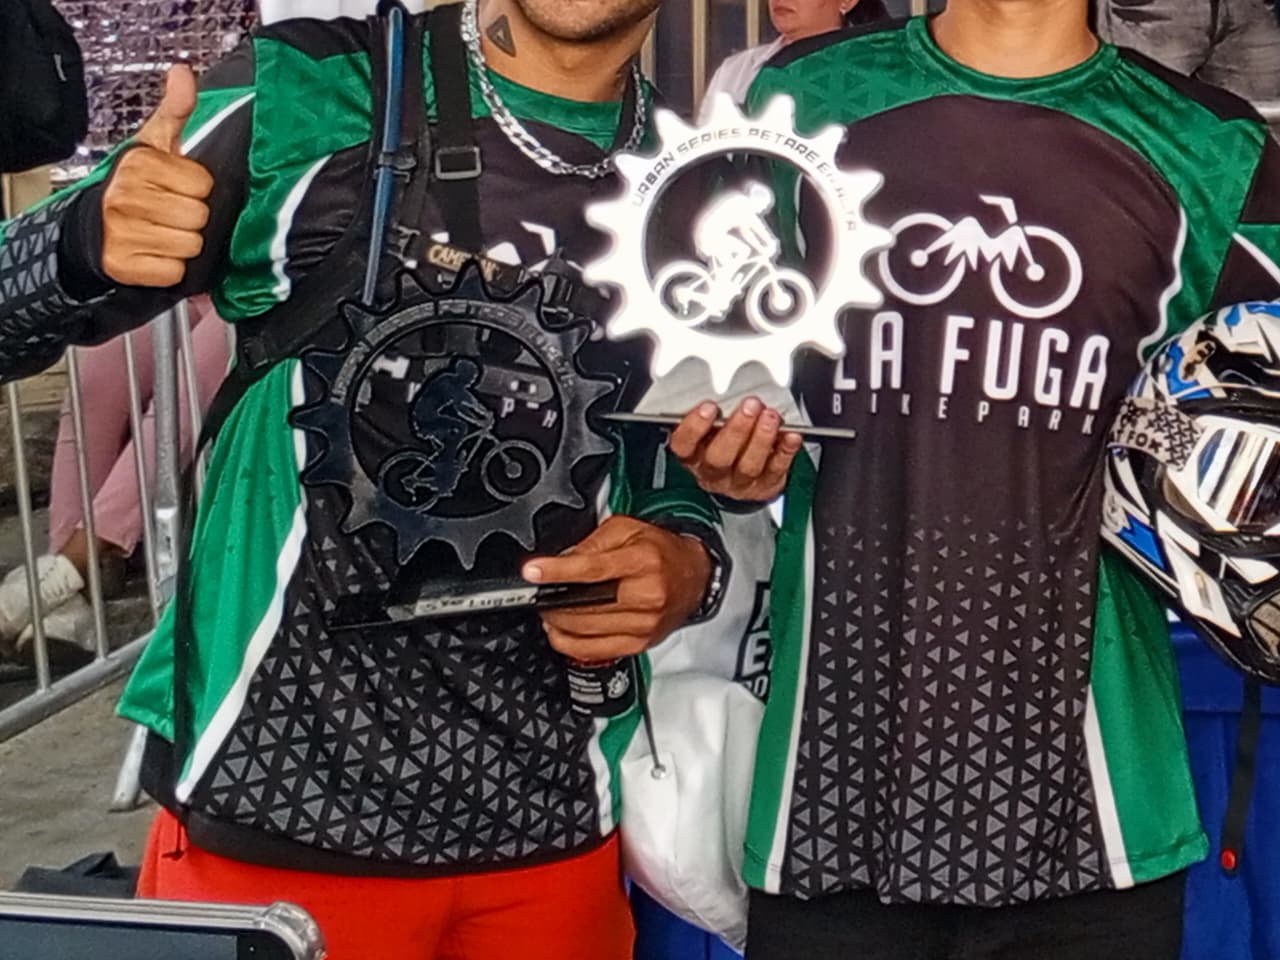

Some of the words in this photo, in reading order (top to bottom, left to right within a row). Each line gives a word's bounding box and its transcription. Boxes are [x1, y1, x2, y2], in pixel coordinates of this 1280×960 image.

[632, 151, 676, 208] URBAN
[676, 127, 743, 155] SERIES
[748, 127, 819, 164] PETARE
[940, 314, 1111, 410] FUGA
